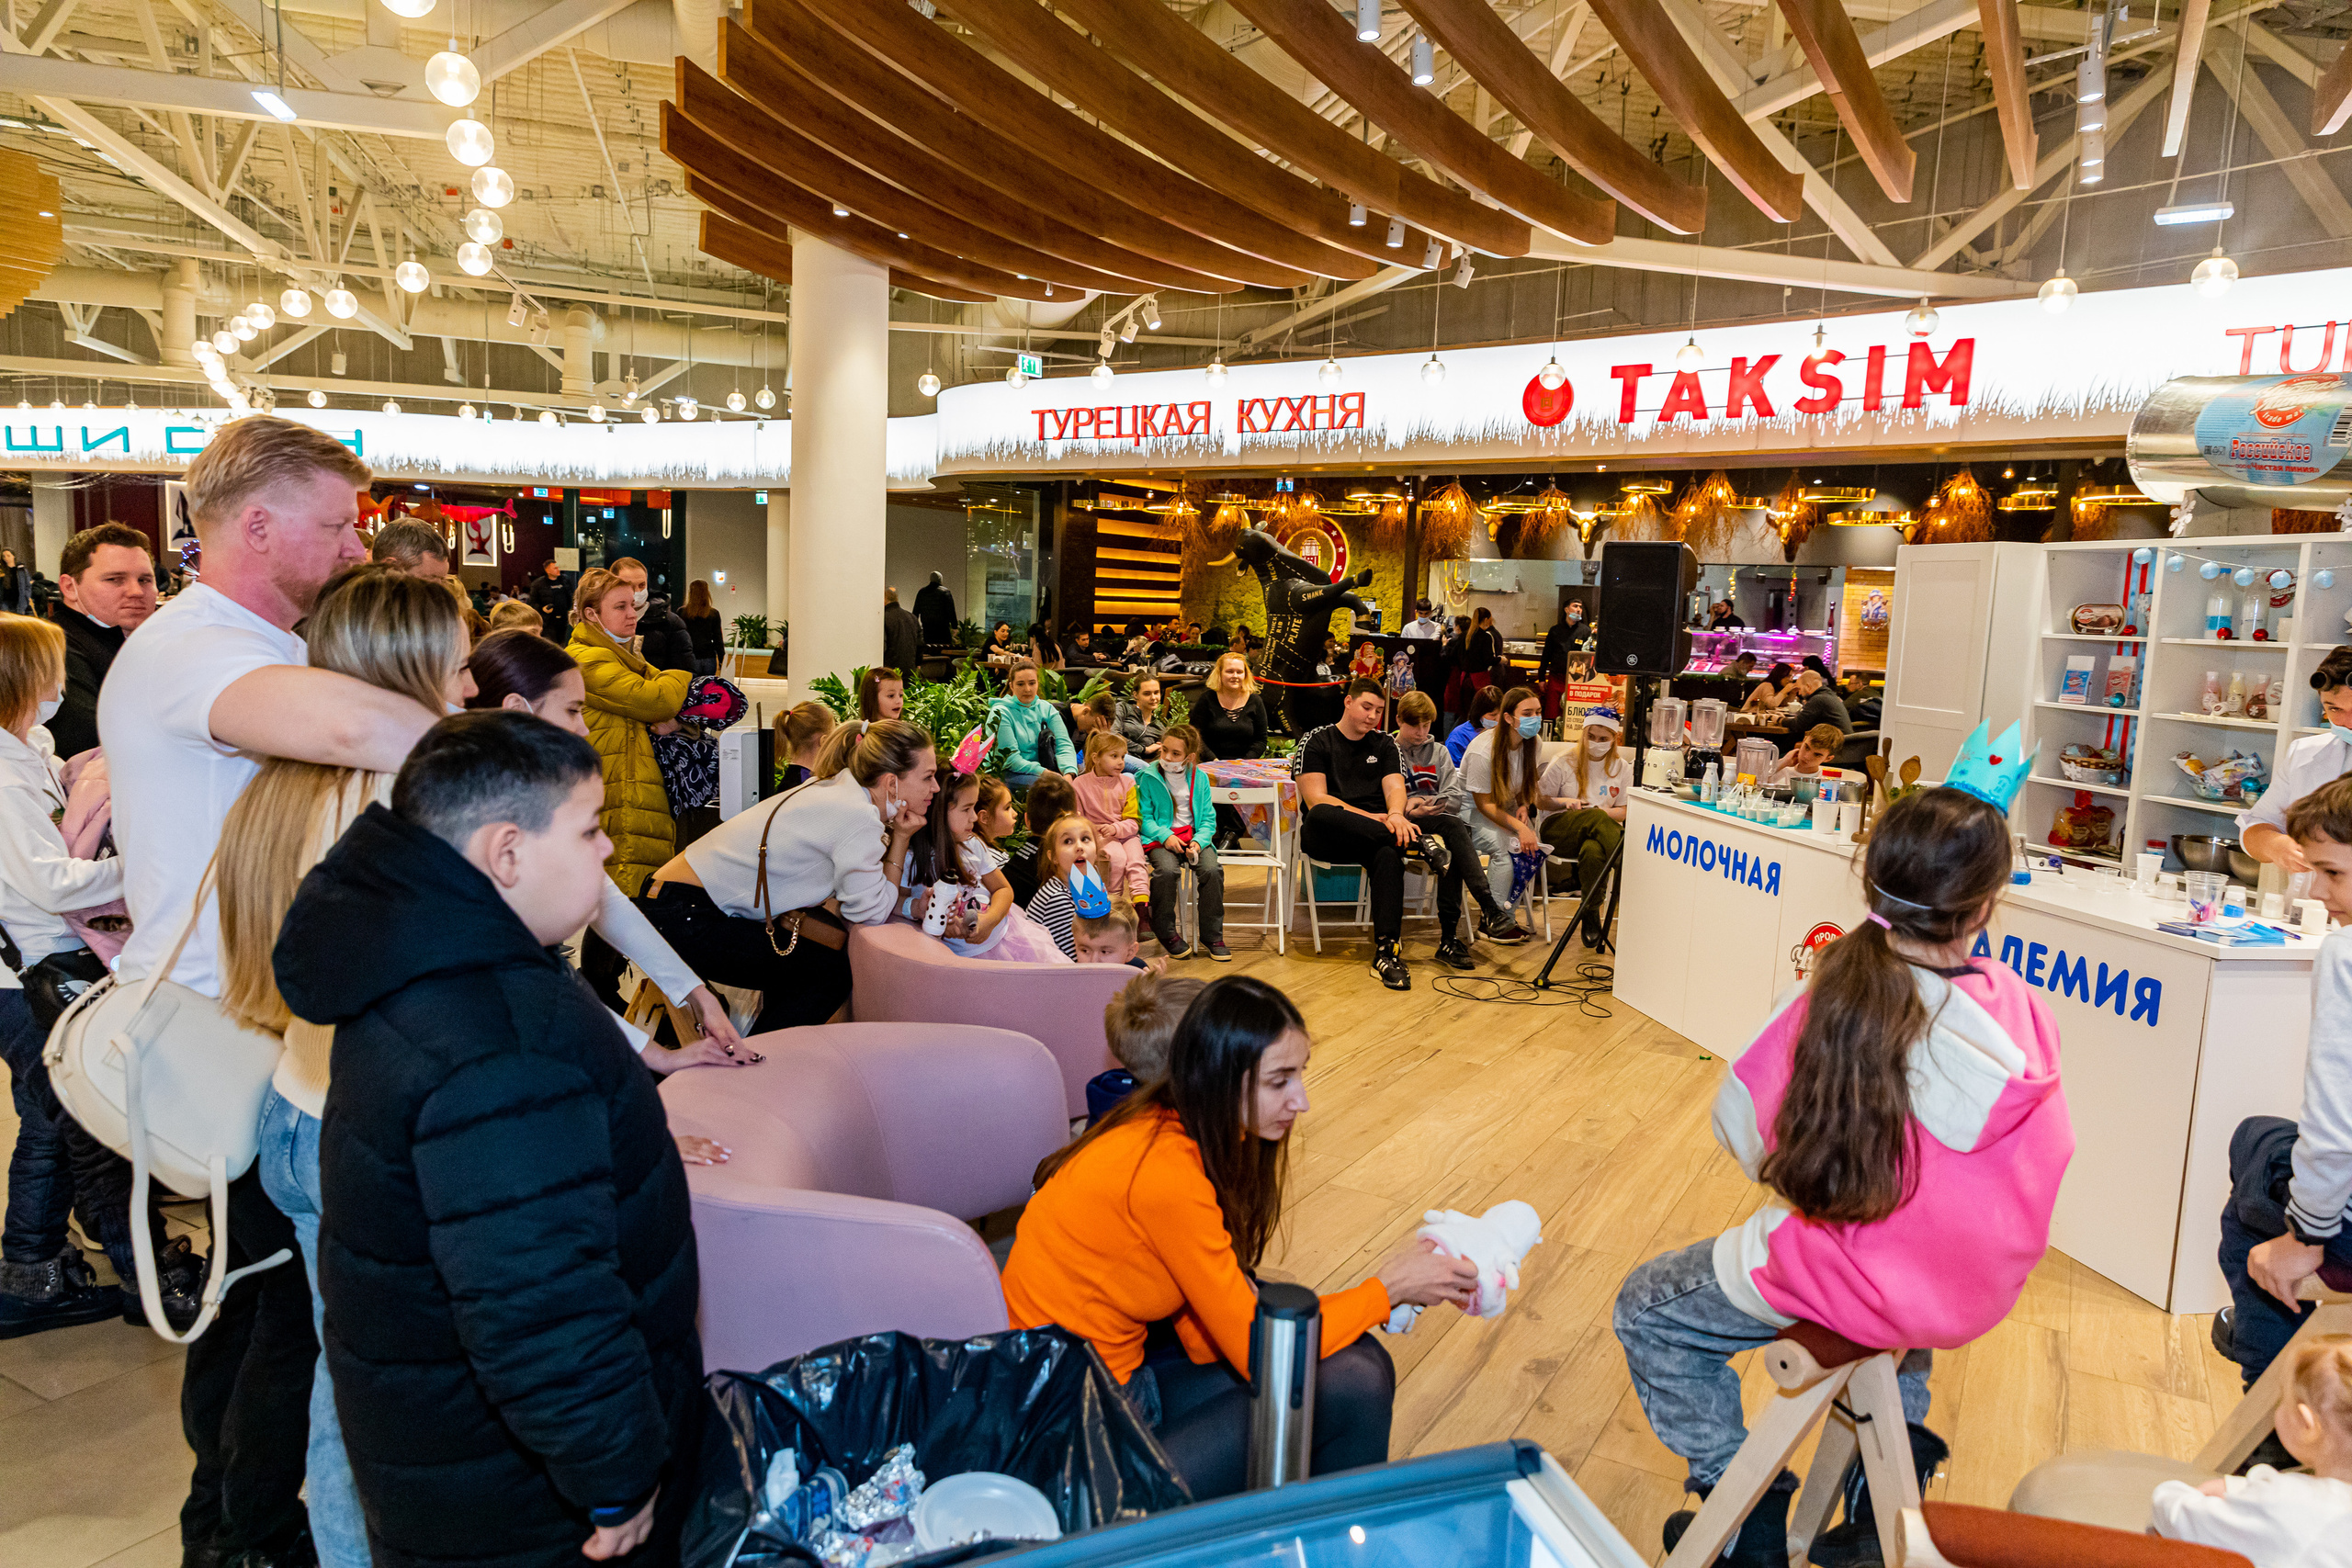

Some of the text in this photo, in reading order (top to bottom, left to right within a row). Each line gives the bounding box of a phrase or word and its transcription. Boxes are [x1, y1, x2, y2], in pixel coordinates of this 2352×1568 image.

[2225, 321, 2352, 375] TU
[1611, 337, 1975, 423] TAKSIM
[1031, 392, 1365, 447] ТУРЕЦКАЯ КУХНЯ
[2230, 437, 2312, 463] Российское
[1301, 589, 1324, 602] SHANK
[1287, 617, 1303, 645] PLATE
[1574, 690, 1601, 698] ПОДАРОК
[1599, 784, 1608, 796] Я
[1645, 823, 1781, 897] МОЛОЧНАЯ
[1971, 928, 2163, 1028] АДЕМИЯ
